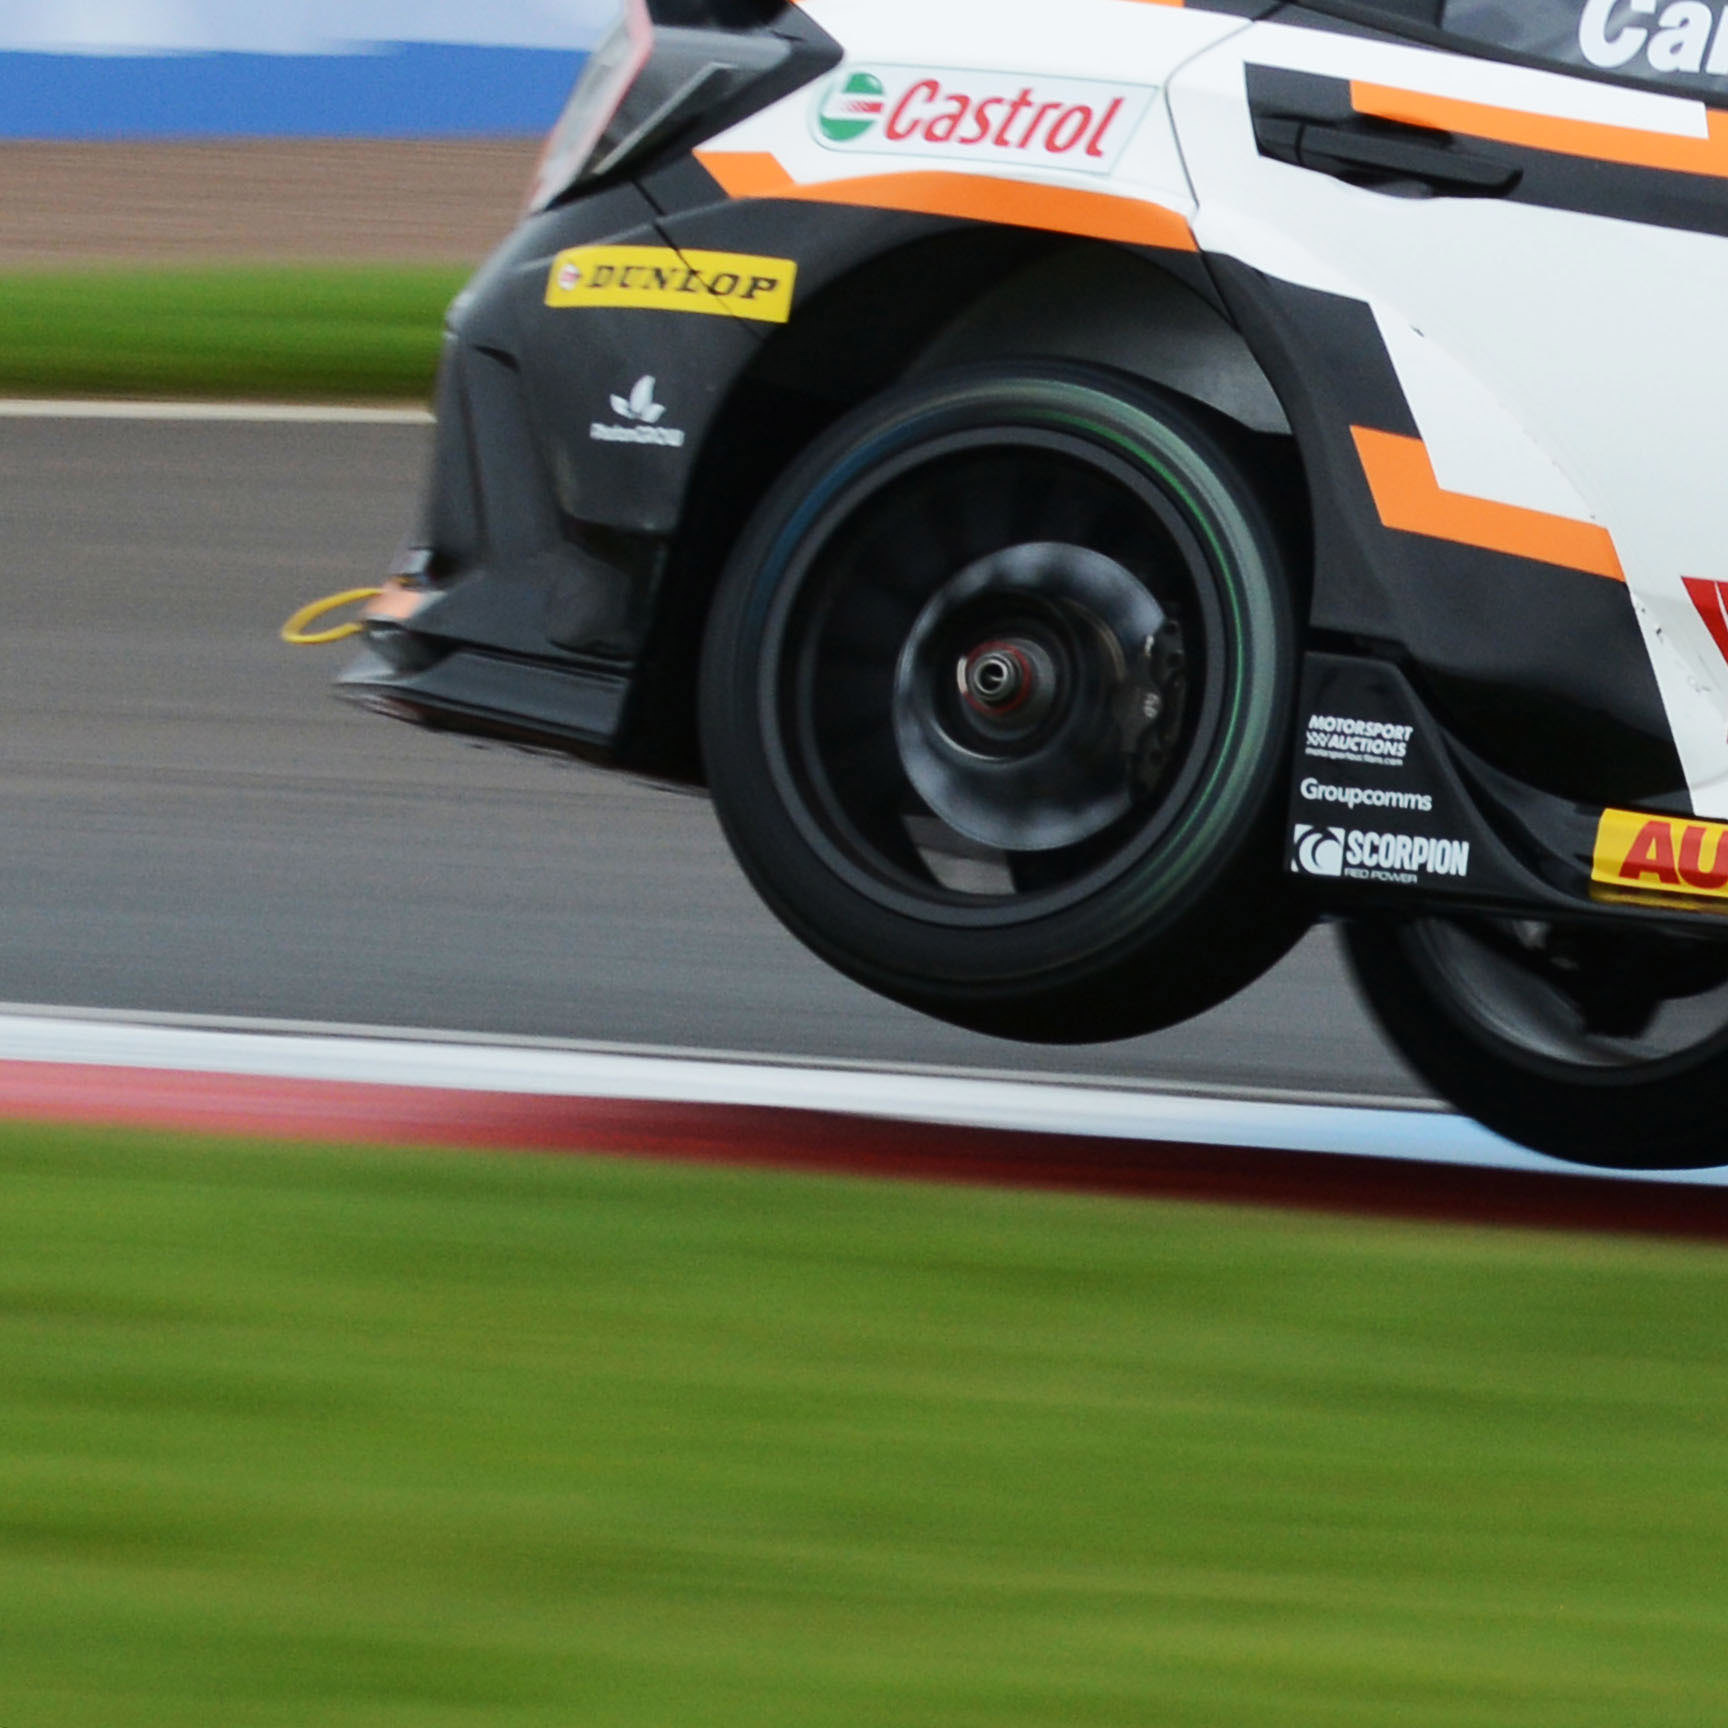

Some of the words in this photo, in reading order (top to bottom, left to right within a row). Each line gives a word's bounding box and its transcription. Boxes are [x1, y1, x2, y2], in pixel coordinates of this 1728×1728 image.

[883, 78, 1125, 158] Castrol
[587, 264, 777, 301] DUNLOP
[1308, 714, 1414, 742] MOTORSPORT
[1327, 733, 1407, 758] AUCTIONS
[1300, 777, 1433, 812] Groupcomms
[1345, 829, 1470, 878] SCORPION
[1344, 867, 1369, 880] RED
[1370, 870, 1418, 884] POWER
